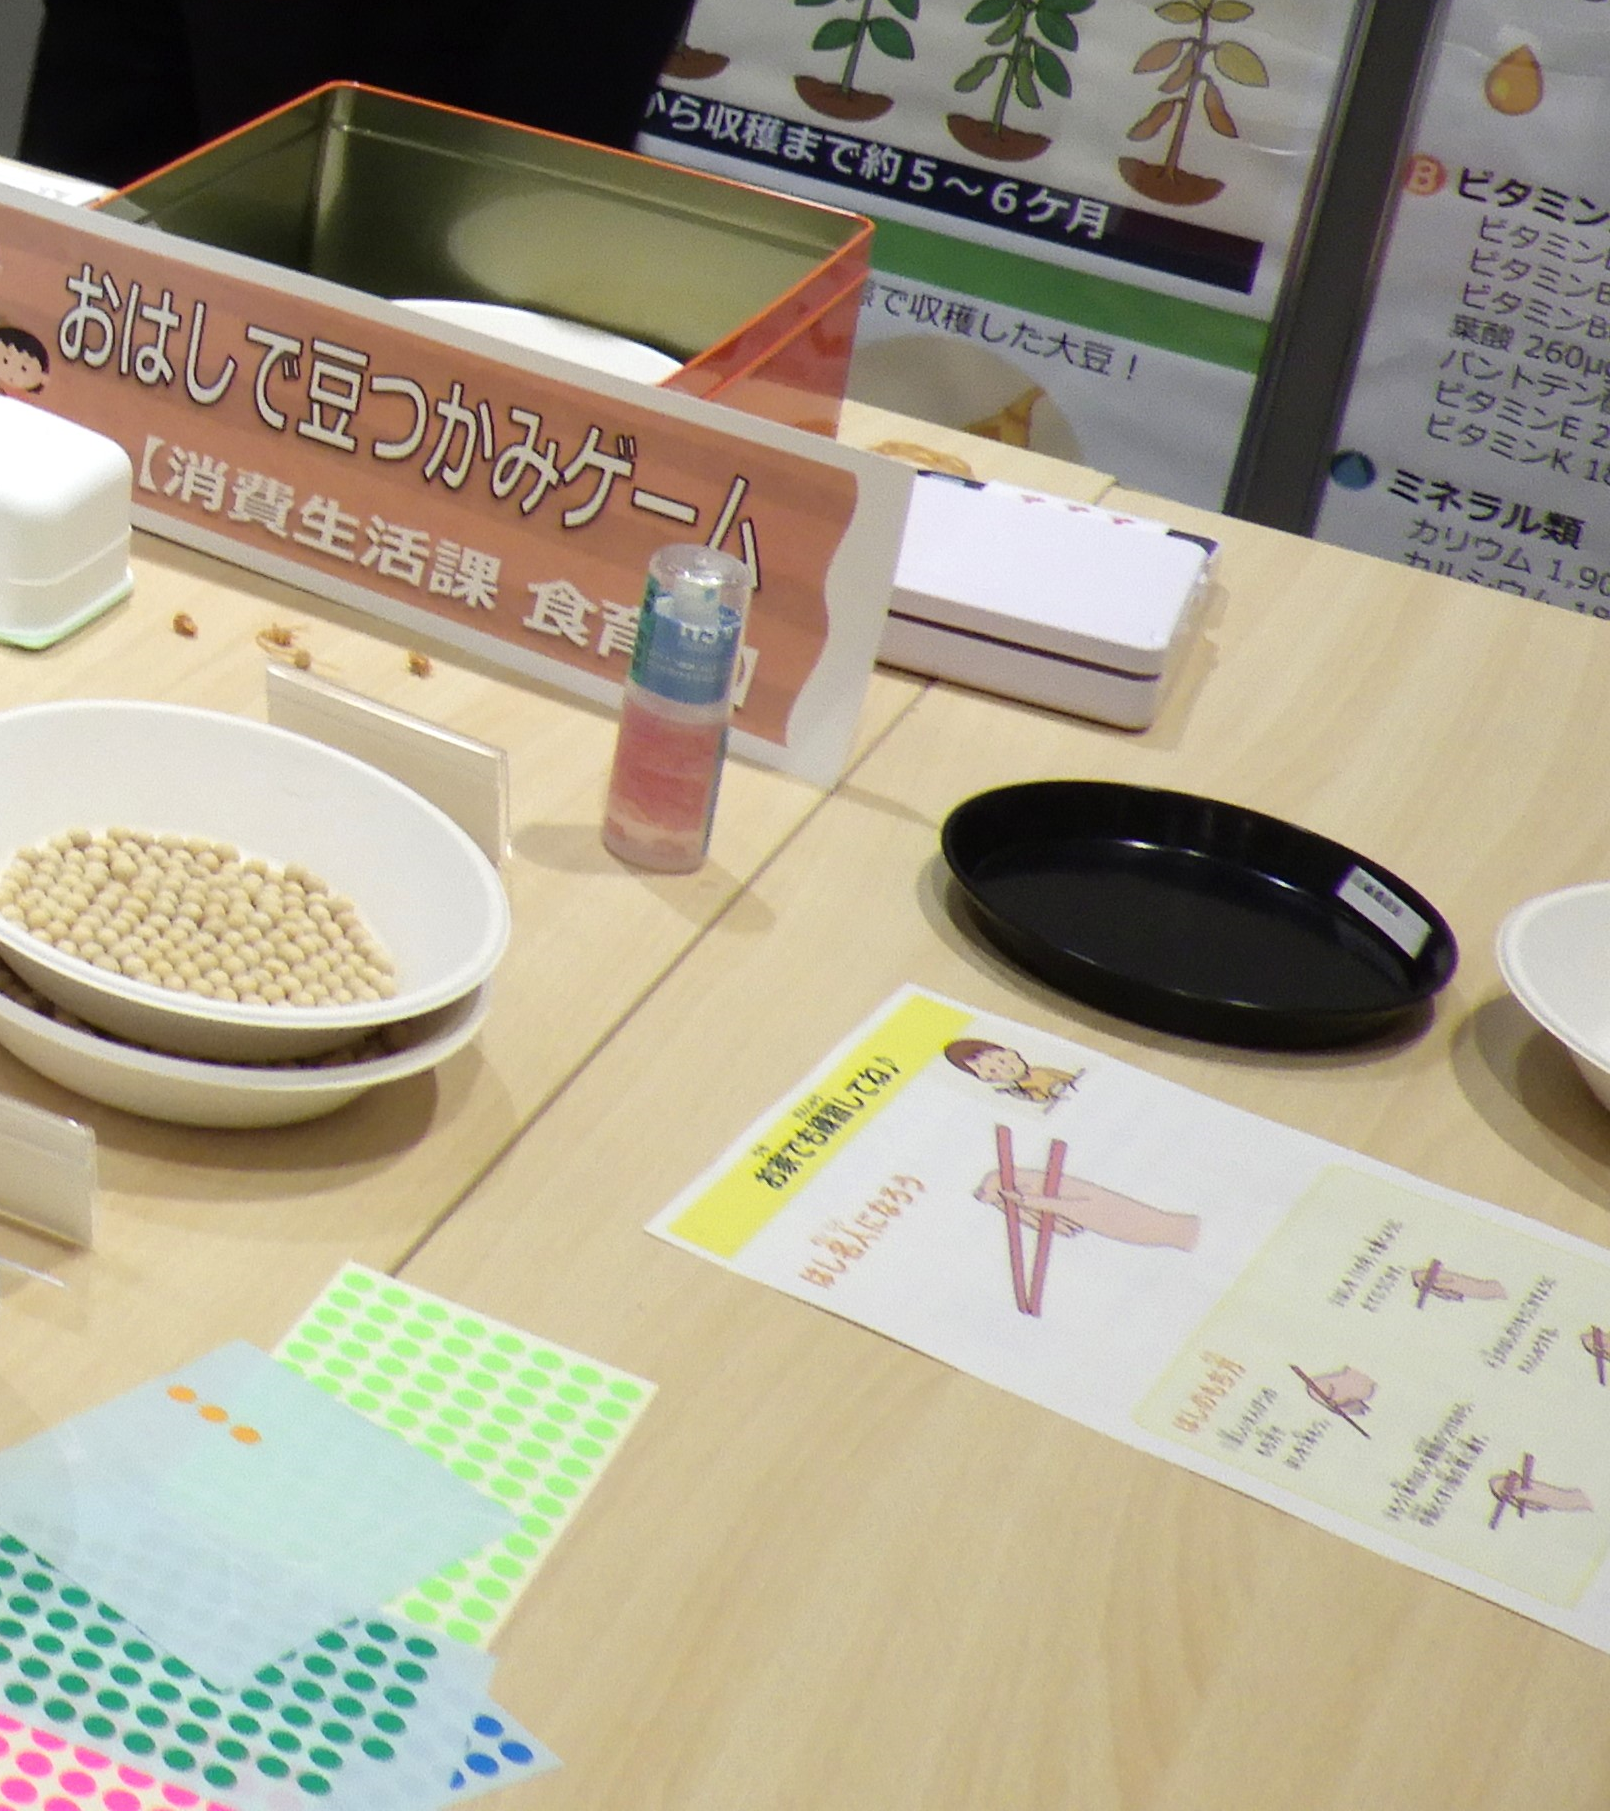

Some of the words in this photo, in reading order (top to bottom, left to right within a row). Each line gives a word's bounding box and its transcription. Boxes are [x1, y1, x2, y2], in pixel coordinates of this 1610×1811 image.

[1480, 214, 1610, 271] ビタミン
[1450, 313, 1515, 353] 葉酸
[54, 261, 764, 591] おはしで豆つかみゲーム
[1435, 379, 1583, 442] ビタミンE
[1426, 412, 1573, 475] ビタミンK
[1387, 467, 1586, 551] ミネラル類
[1408, 518, 1533, 575] カリウム
